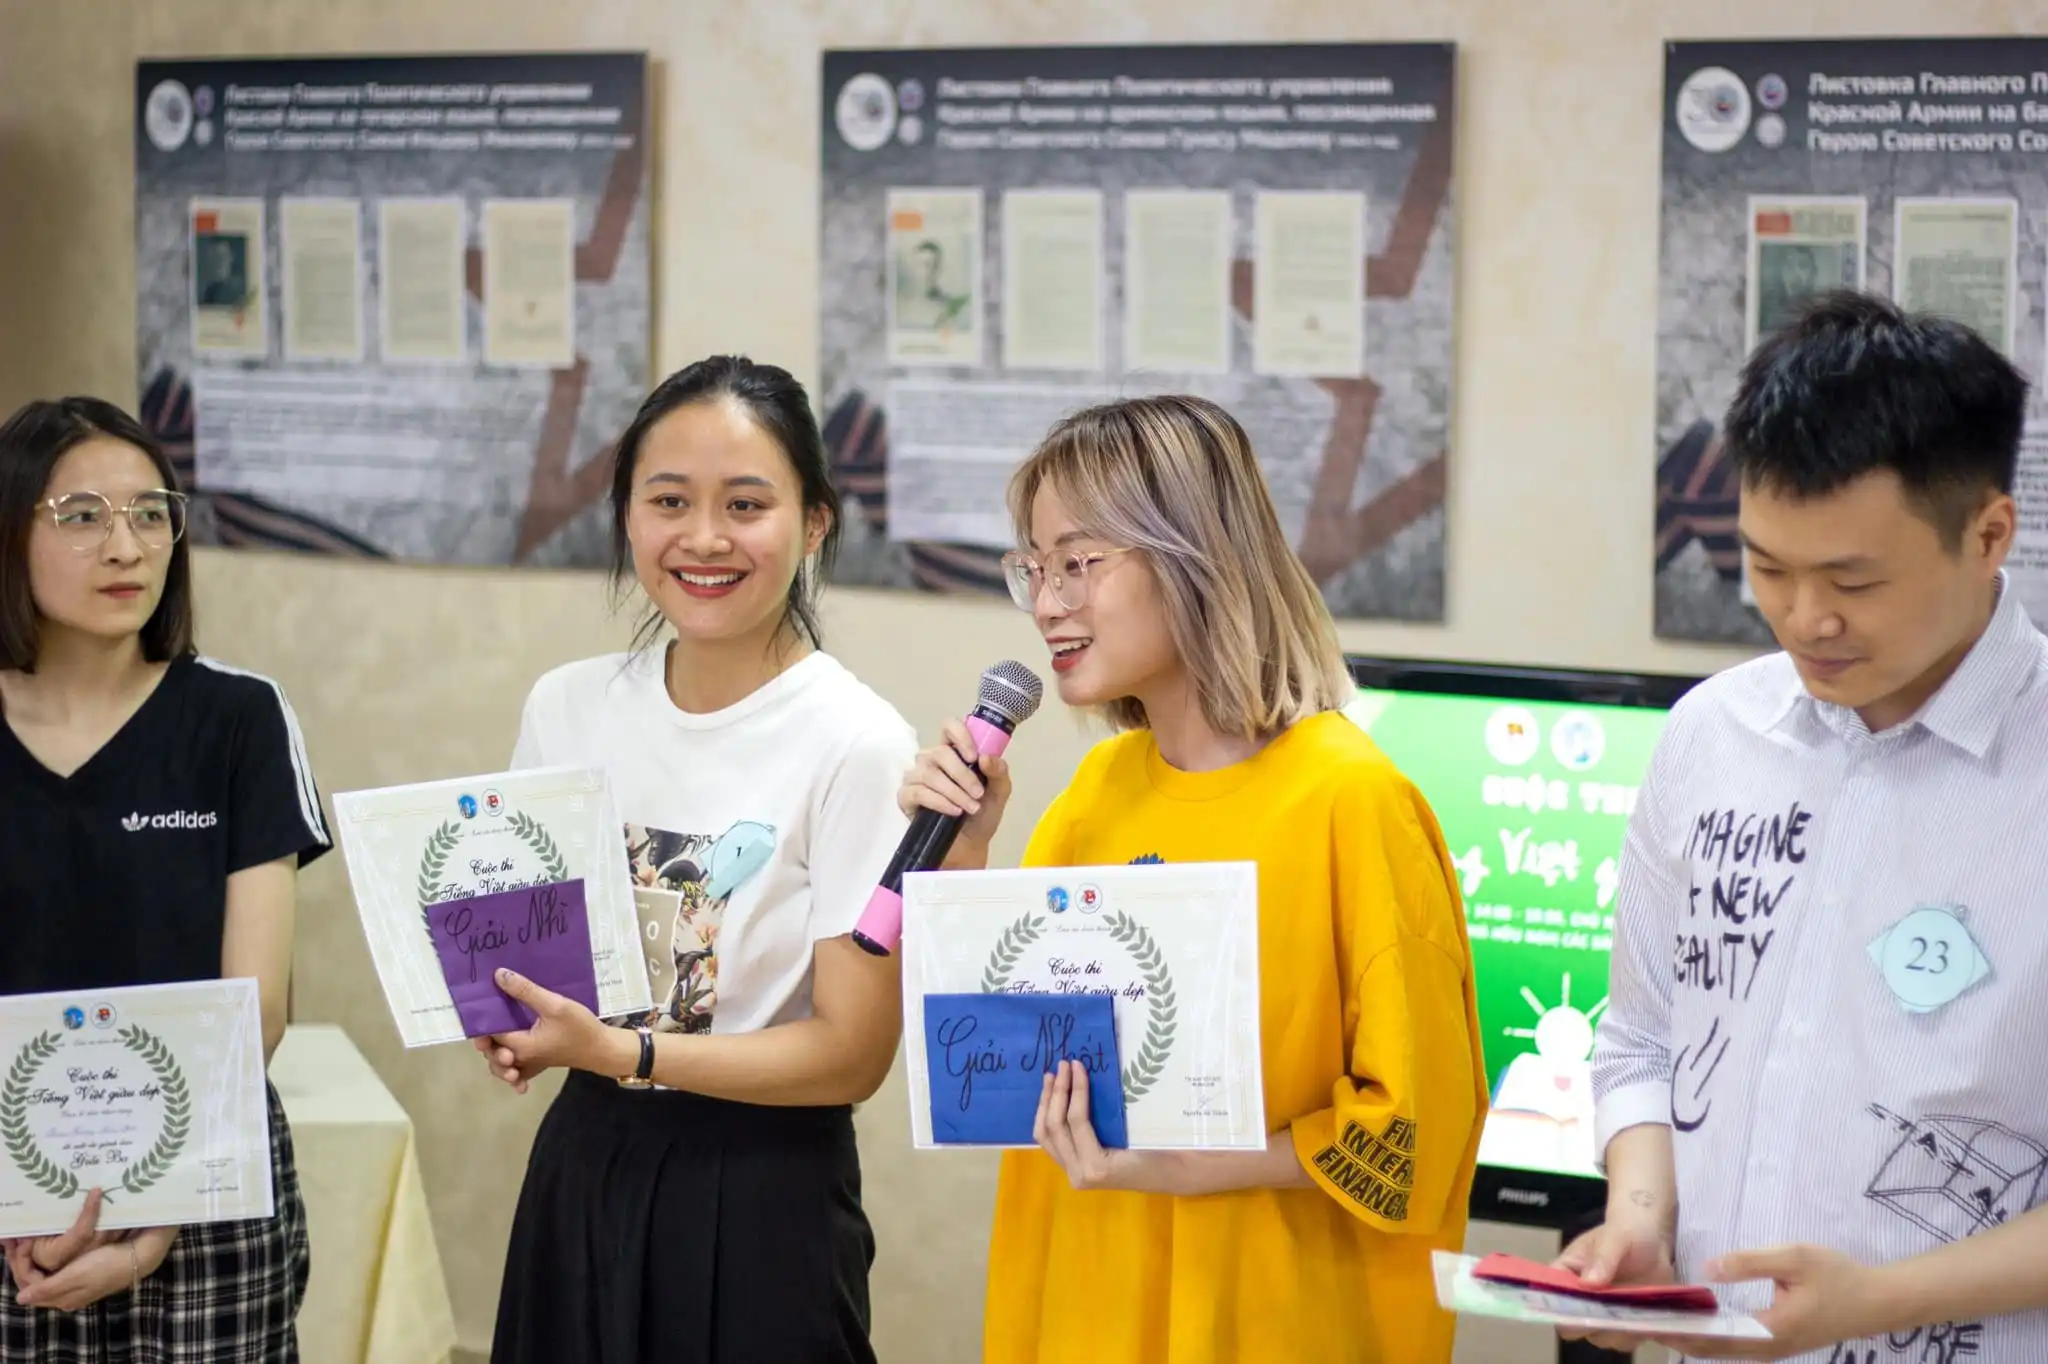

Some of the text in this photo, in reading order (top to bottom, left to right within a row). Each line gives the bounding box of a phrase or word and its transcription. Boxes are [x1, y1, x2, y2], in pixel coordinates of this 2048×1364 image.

[1808, 72, 1915, 95] Листовка
[1919, 72, 2026, 95] Главного
[1807, 100, 1902, 126] Красной
[1907, 100, 1983, 127] Армии
[1988, 104, 2017, 123] на
[1807, 129, 1878, 154] Герою
[1882, 129, 2013, 151] Советского
[151, 809, 217, 829] adidas
[1712, 870, 1794, 925] NEW
[444, 887, 569, 983] Giải Nhì
[1085, 959, 1102, 975] thi
[1904, 936, 1949, 974] 23
[937, 1014, 1008, 1112] Giải
